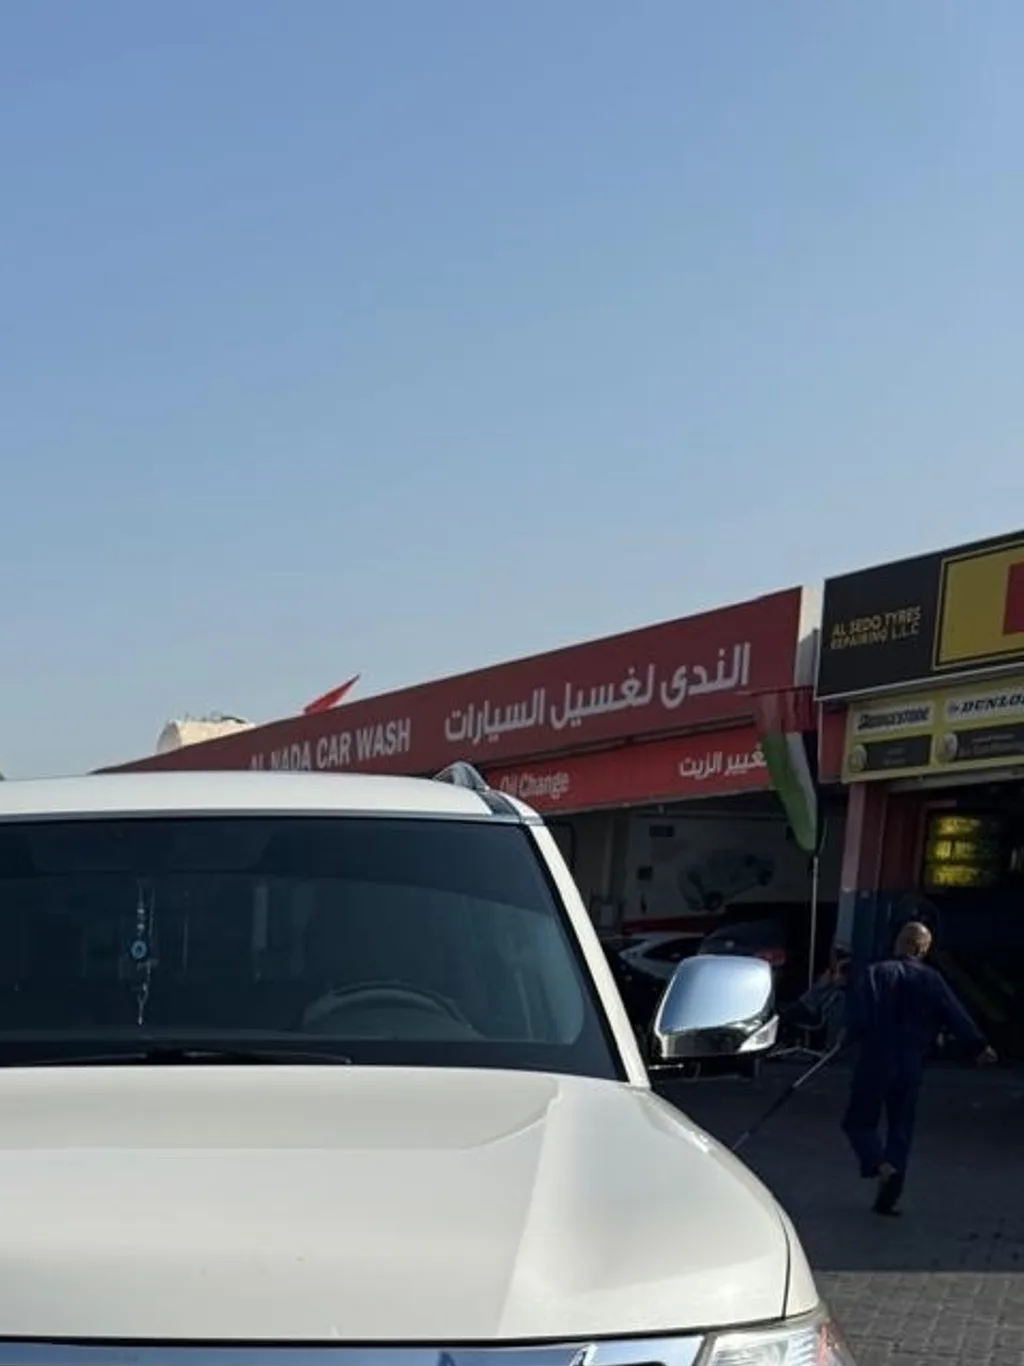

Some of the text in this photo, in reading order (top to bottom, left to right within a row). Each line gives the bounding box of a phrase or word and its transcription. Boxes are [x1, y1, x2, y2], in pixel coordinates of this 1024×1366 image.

[444, 642, 752, 744] الندى لغسيل السيارات
[316, 731, 352, 769] CAR
[356, 717, 412, 760] WASH
[678, 742, 767, 780] غيير الزيت
[519, 771, 570, 800] Change
